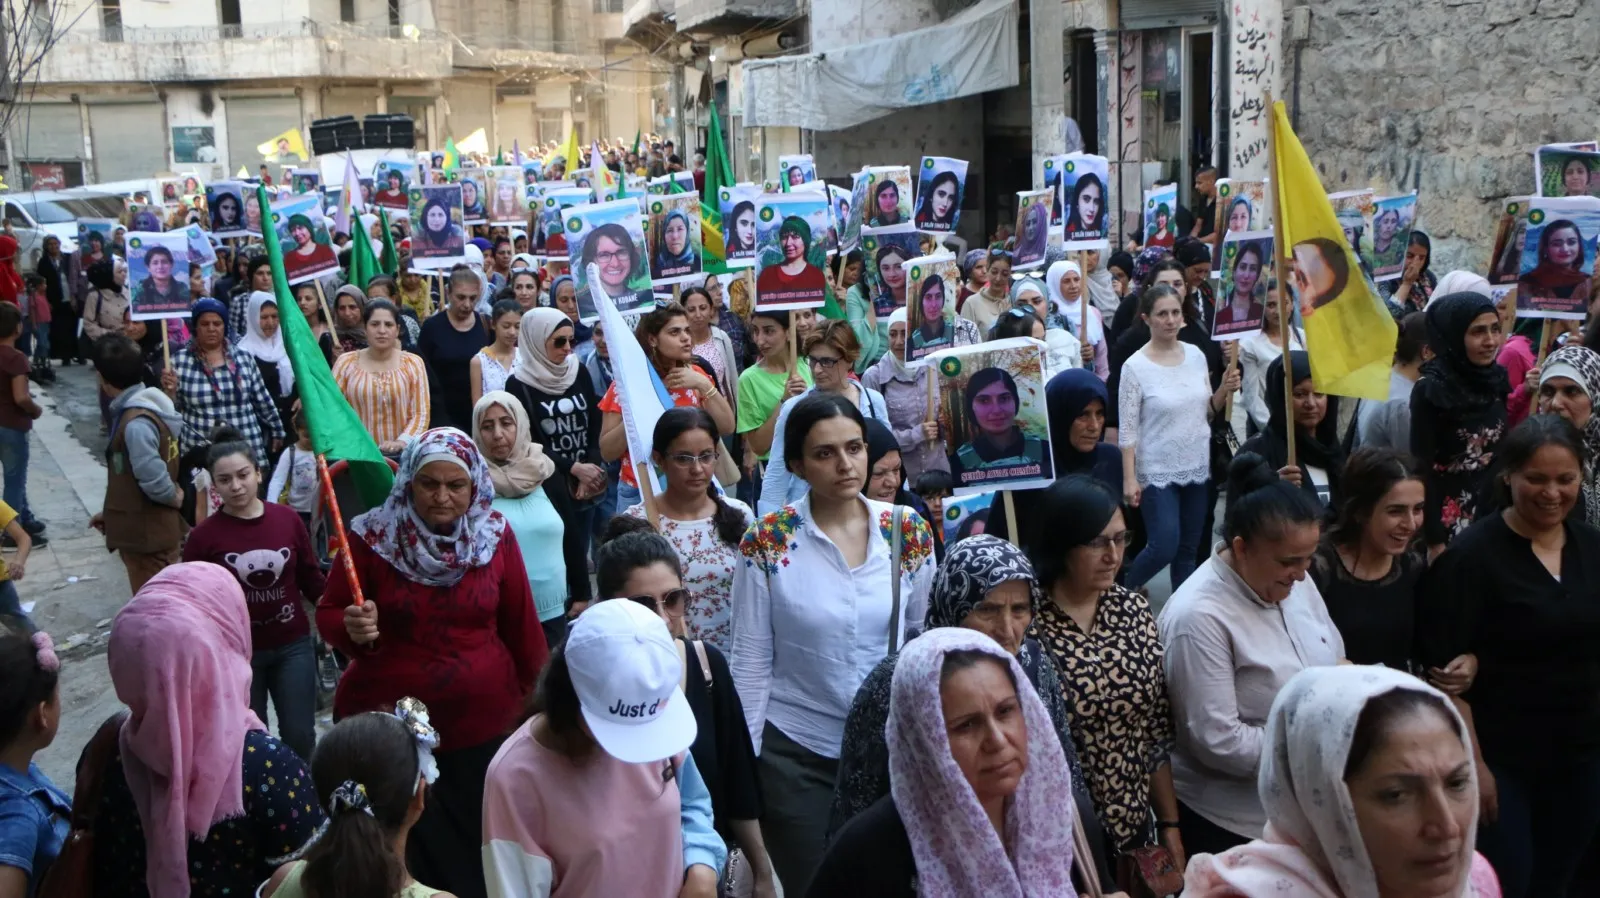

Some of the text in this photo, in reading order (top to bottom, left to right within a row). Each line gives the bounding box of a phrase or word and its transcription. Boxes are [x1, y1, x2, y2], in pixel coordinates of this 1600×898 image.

[540, 393, 588, 417] YOU
[551, 430, 588, 451] LOVE
[609, 699, 646, 718] Just
